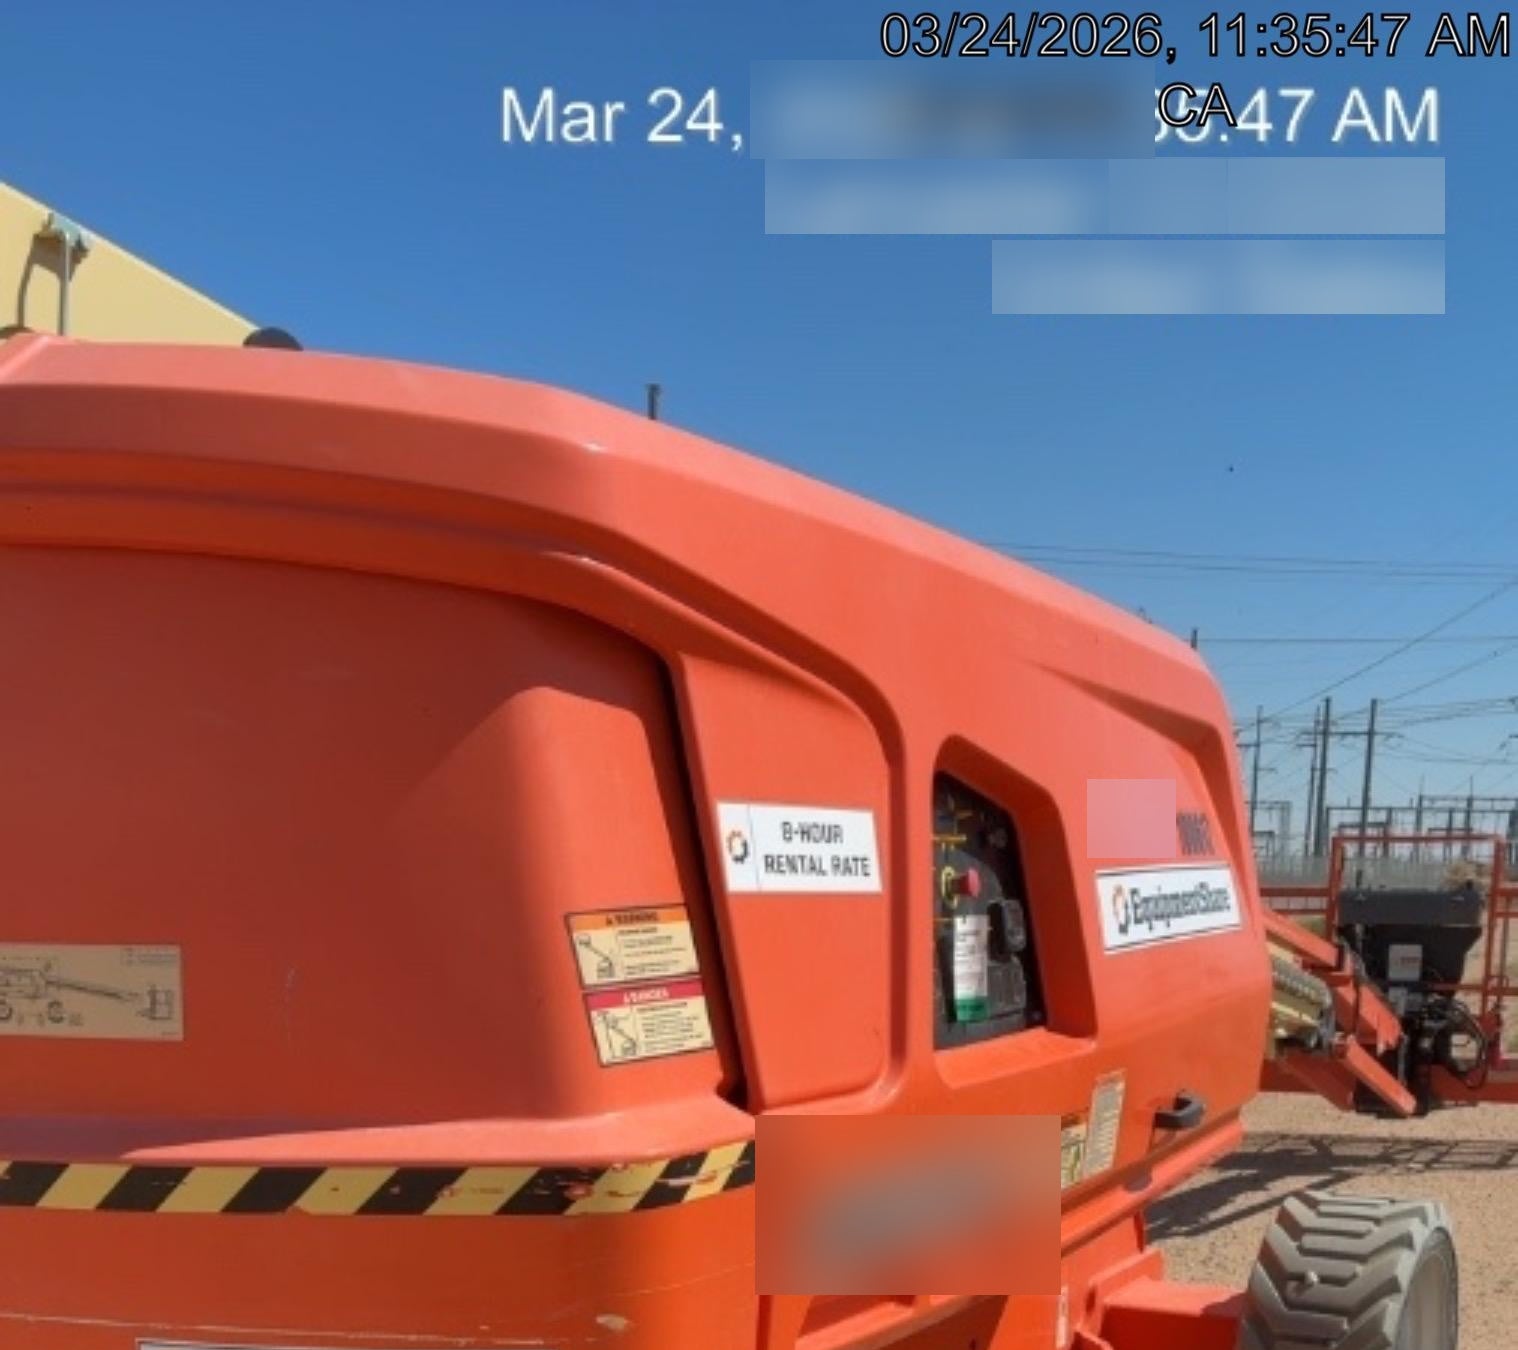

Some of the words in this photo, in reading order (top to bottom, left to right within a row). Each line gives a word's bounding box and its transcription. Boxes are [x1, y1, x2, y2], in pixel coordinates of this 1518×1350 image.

[763, 853, 827, 877] RENTAL
[830, 855, 871, 877] RATE
[1130, 881, 1231, 932] EquipmentShare
